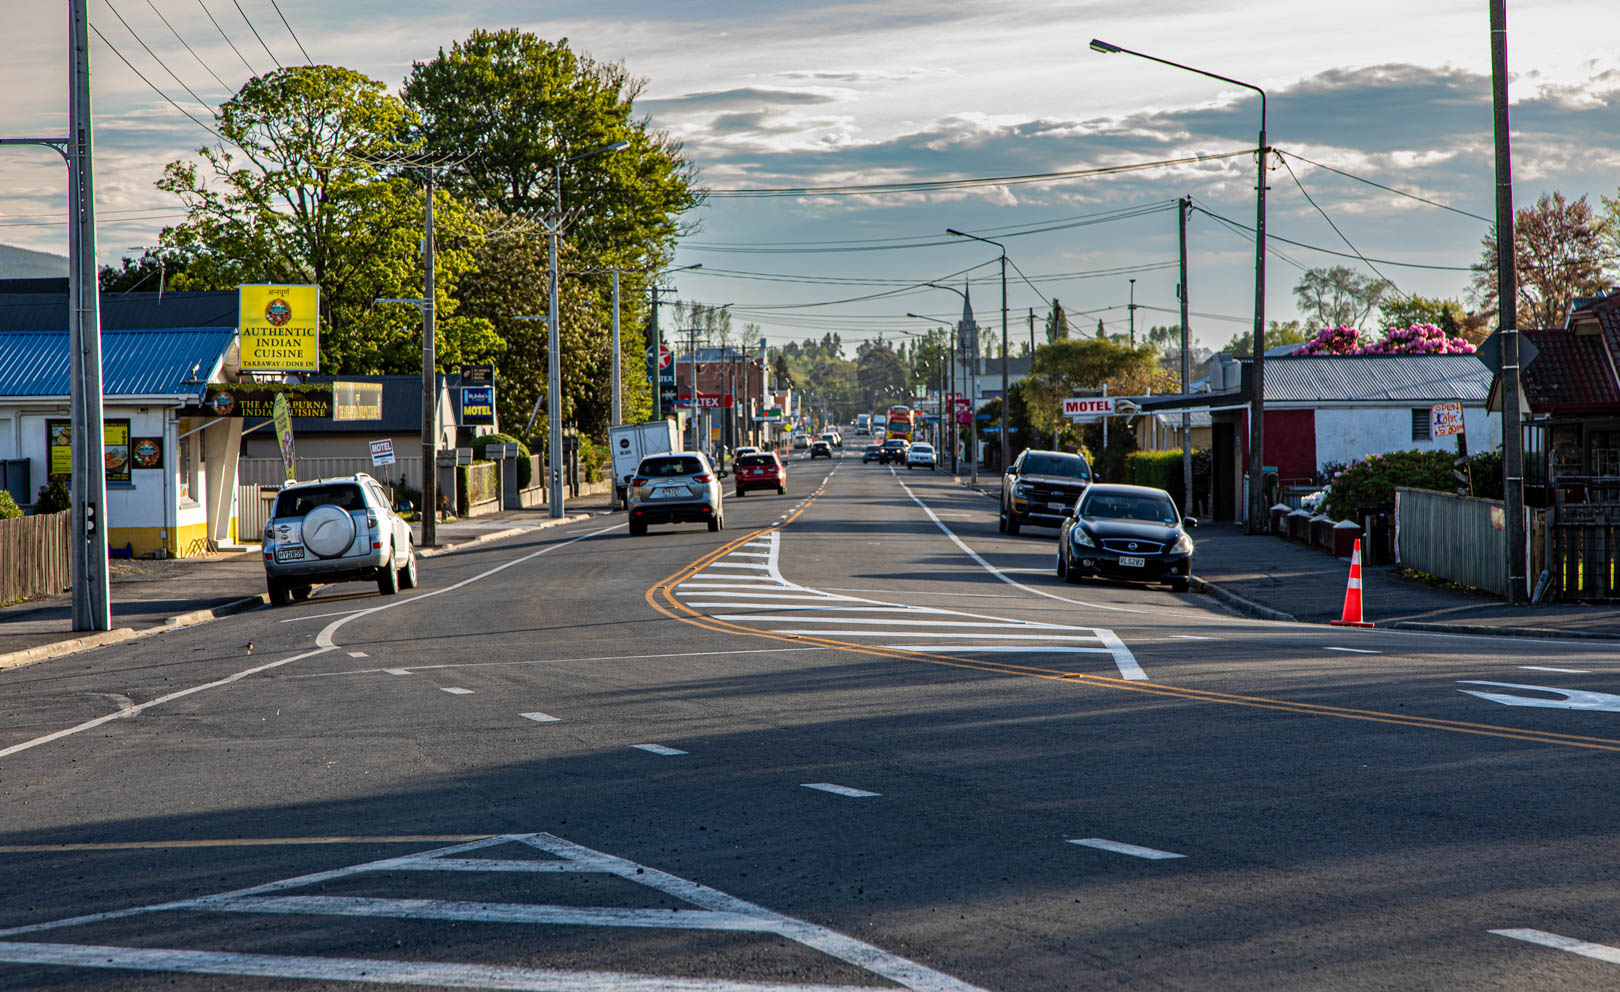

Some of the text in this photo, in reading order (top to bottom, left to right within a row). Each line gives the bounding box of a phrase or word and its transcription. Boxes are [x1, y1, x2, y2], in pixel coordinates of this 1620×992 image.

[243, 328, 315, 337] AUTHENTIC
[256, 338, 302, 347] INDIAN
[254, 349, 303, 358] CUISINE
[240, 400, 260, 409] THE
[1065, 400, 1112, 412] MOTEL
[1435, 402, 1459, 412] OPEN
[242, 408, 326, 417] INDIA UISINE
[464, 405, 492, 416] MOTEL
[371, 441, 392, 453] MOTEL
